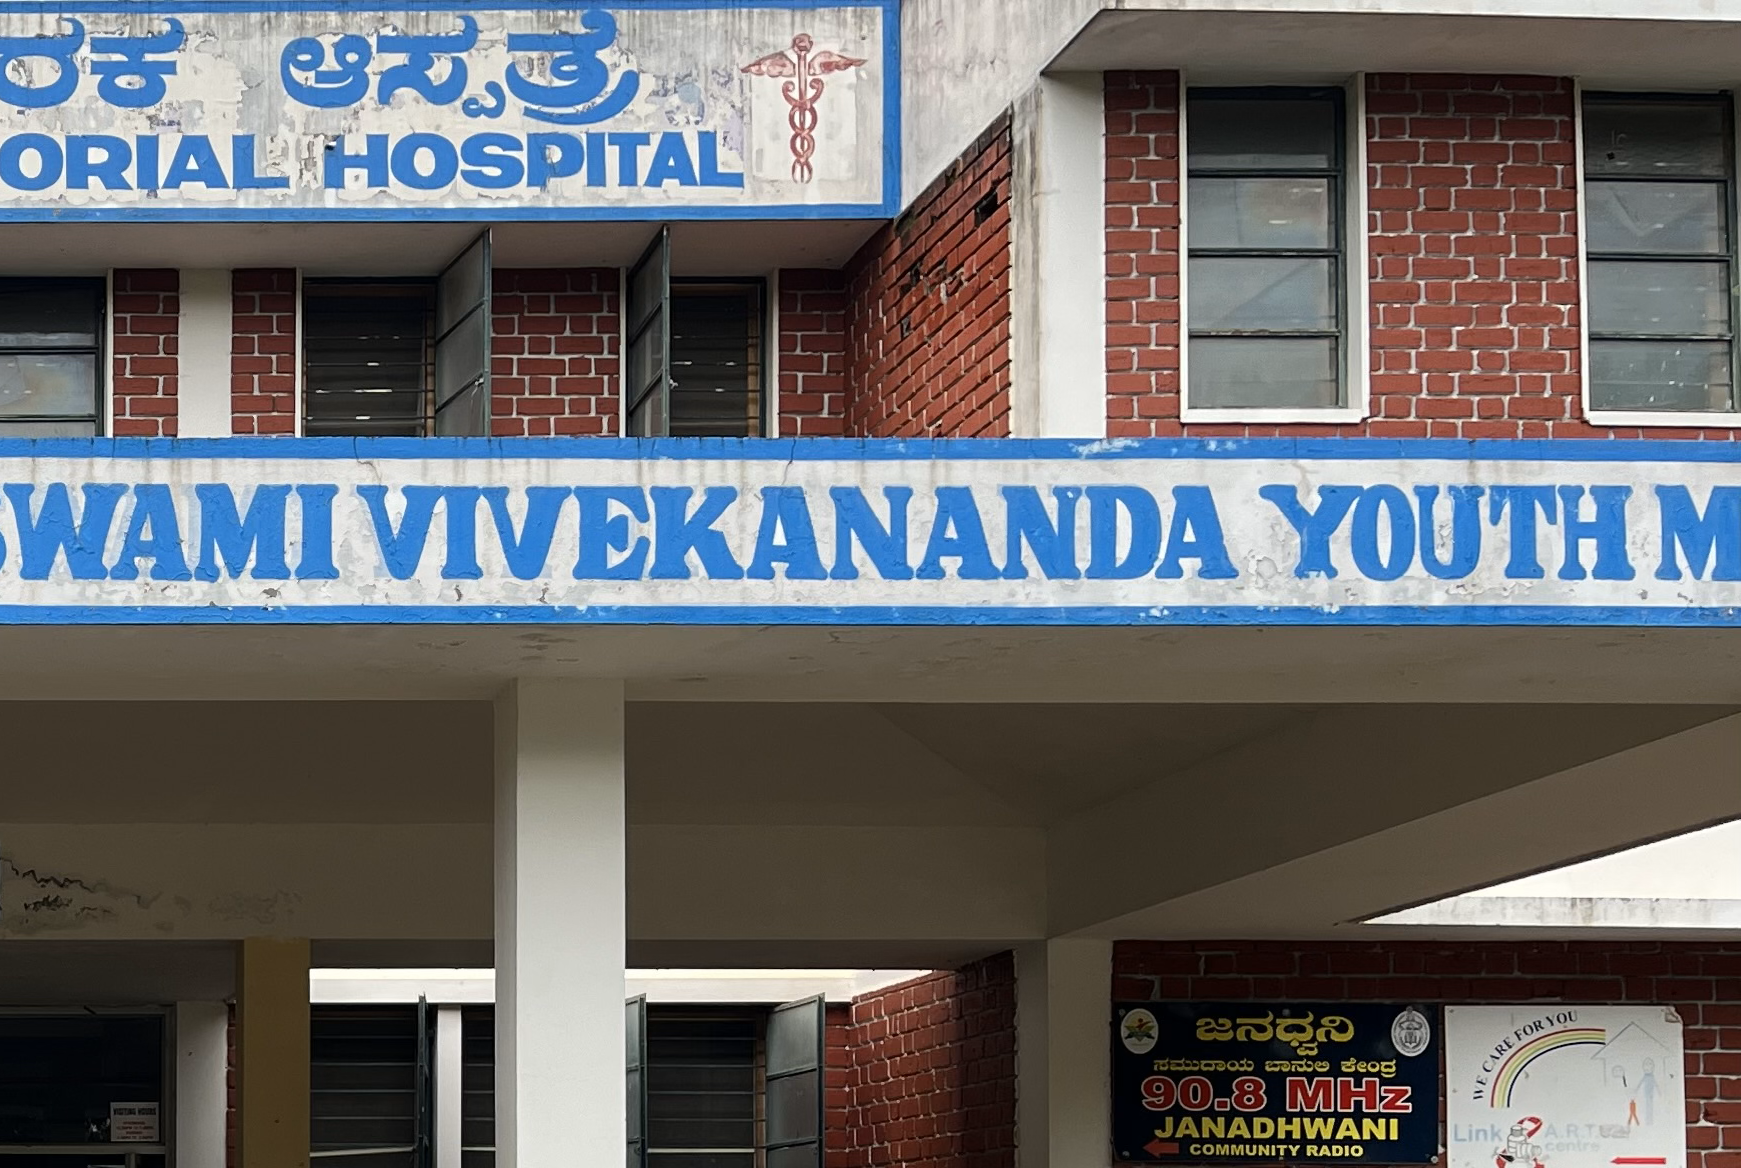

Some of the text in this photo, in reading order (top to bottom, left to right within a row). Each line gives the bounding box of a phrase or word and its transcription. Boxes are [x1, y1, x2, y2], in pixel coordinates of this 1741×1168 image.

[280, 9, 640, 125] ಆಸ್ಪತ್ರೆ
[325, 132, 744, 190] HOSPITAL
[356, 485, 1239, 581] VIVEKANANDA
[1259, 484, 1636, 582] YOUTH
[1473, 1010, 1578, 1100] WE CARE FOR YOU
[1141, 1075, 1412, 1113] 90.8 MHz
[1154, 1116, 1400, 1141] JANADHWANI
[1454, 1123, 1503, 1143] Link
[1544, 1138, 1600, 1152] centre
[1189, 1144, 1364, 1158] COMMUNITY RADIO
